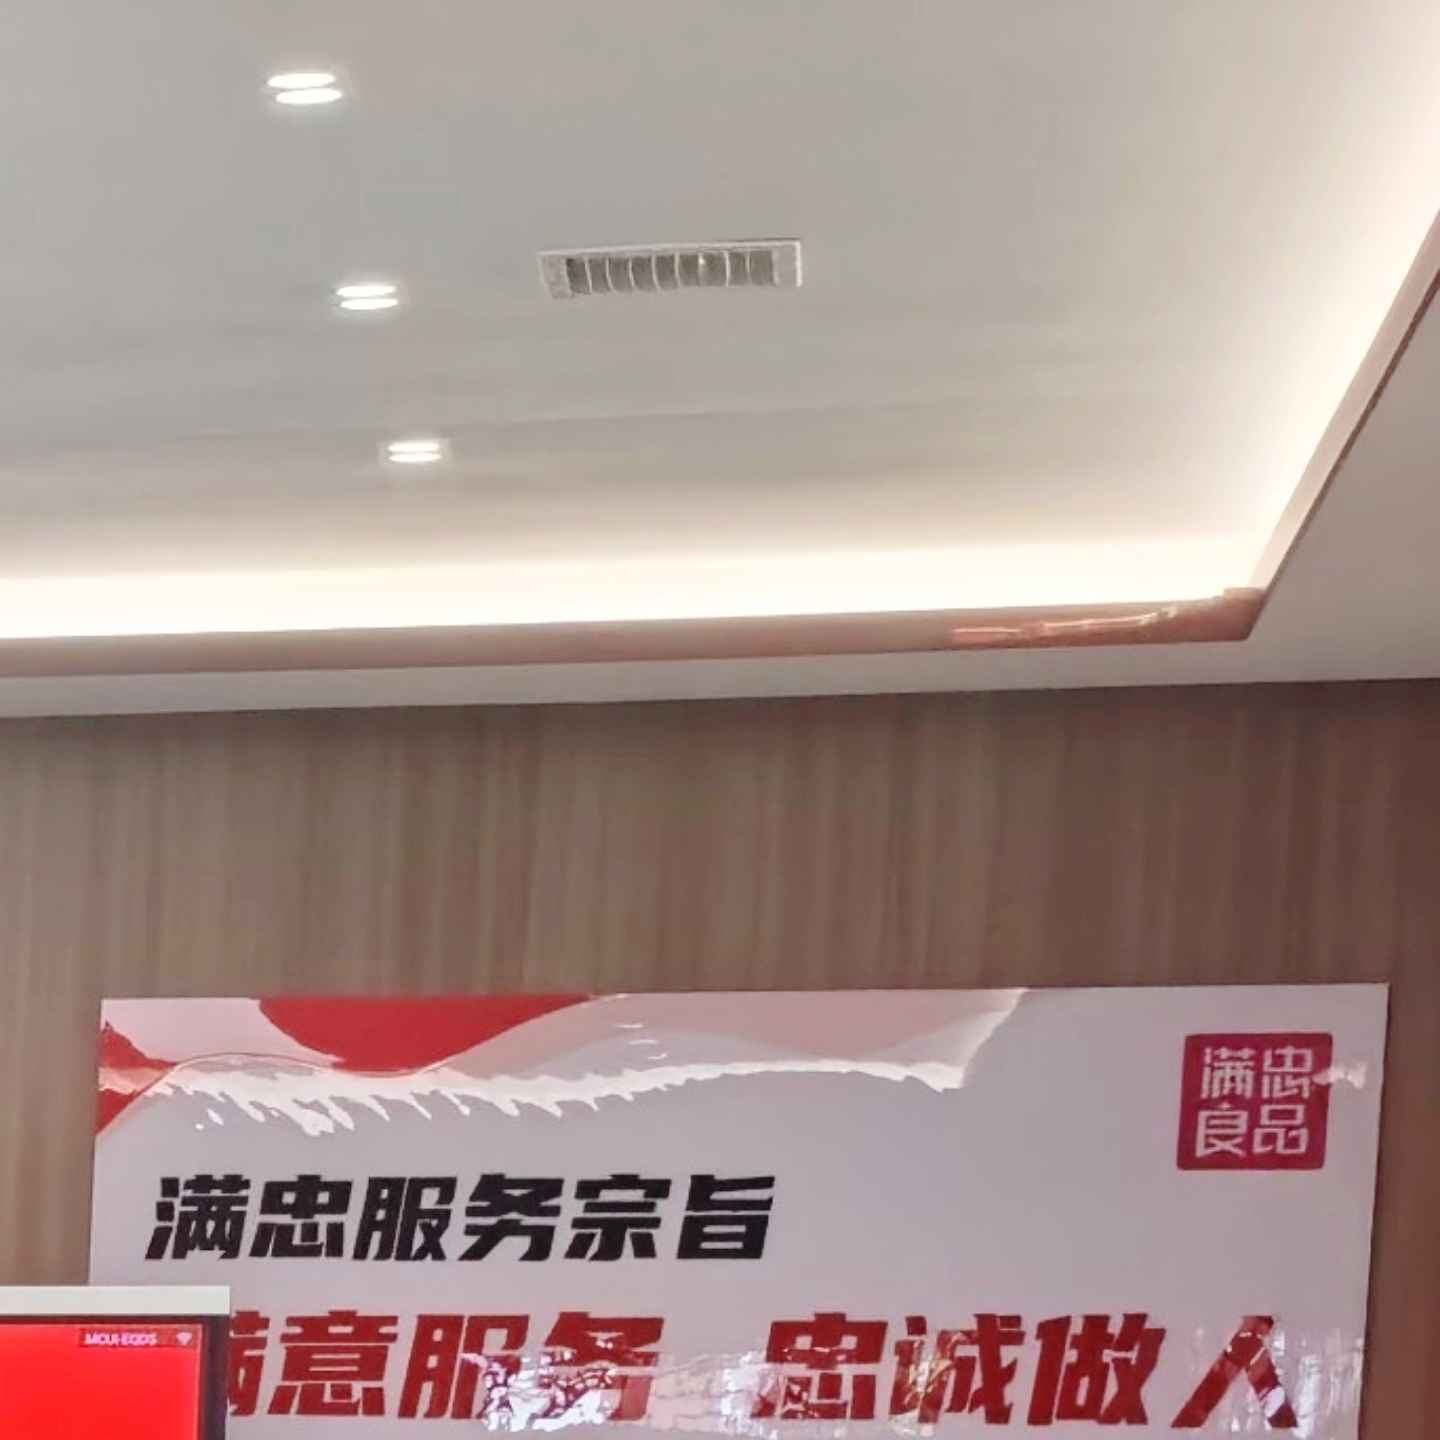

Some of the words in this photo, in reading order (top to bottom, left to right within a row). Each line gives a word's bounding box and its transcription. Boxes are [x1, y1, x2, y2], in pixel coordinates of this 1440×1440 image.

[1200, 1046, 1313, 1099] 满忠
[1195, 1102, 1310, 1158] 良品
[144, 1172, 777, 1264] 满忠服务宗旨
[749, 1311, 1299, 1429] 忠诚做人
